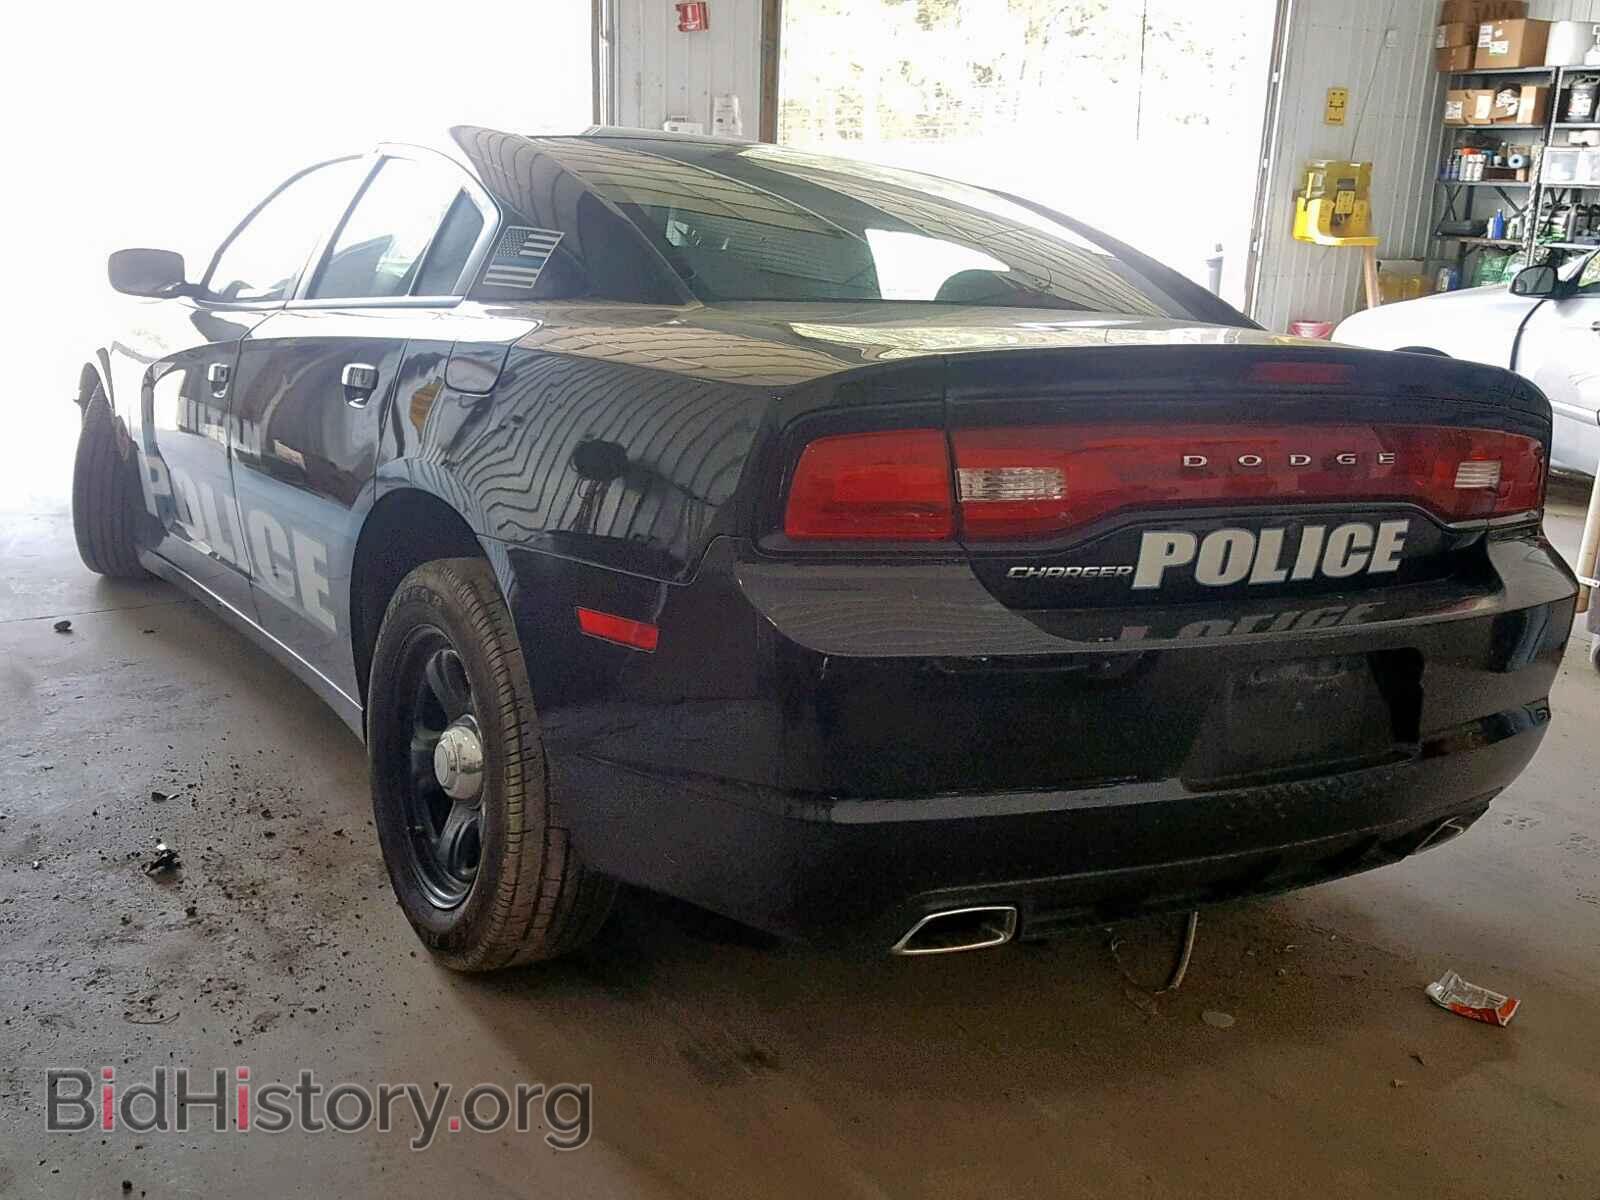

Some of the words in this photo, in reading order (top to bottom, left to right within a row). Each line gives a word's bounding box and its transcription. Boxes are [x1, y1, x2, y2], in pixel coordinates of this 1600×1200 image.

[1183, 452, 1397, 468] DODGE
[1131, 519, 1409, 590] POLICE
[1007, 565, 1134, 579] CHARGER
